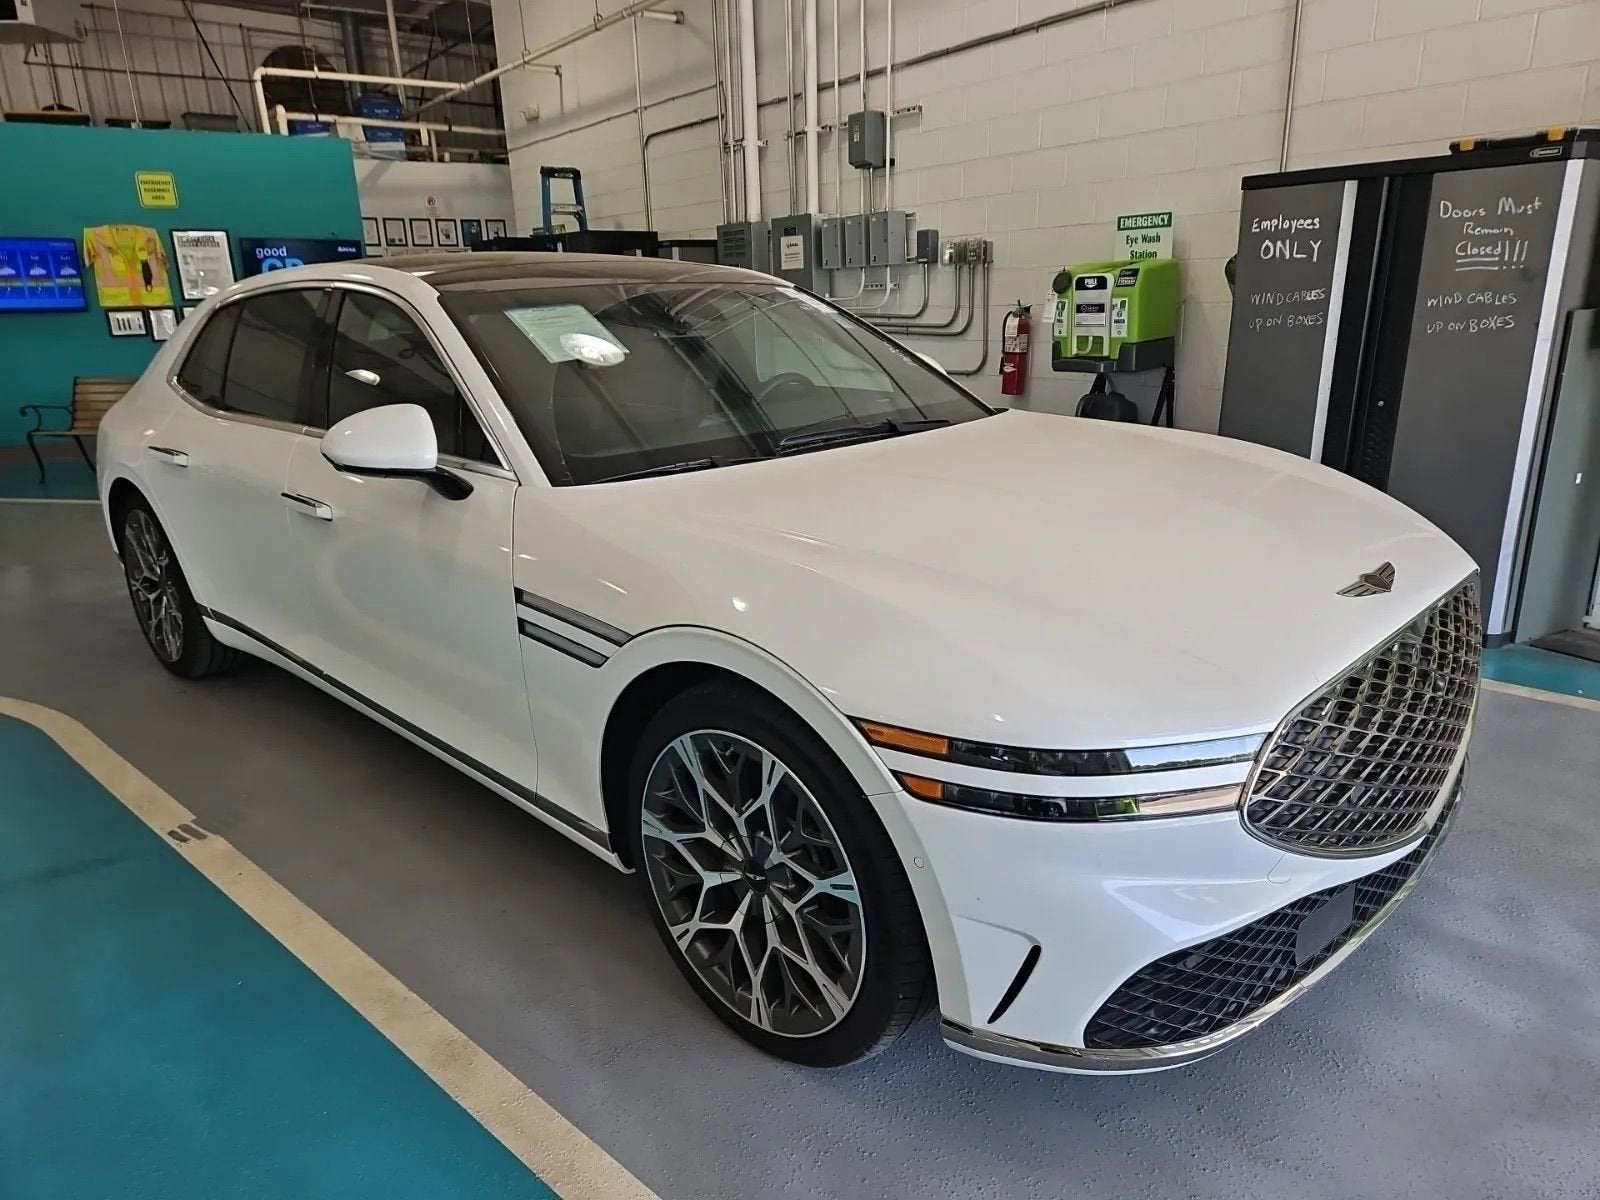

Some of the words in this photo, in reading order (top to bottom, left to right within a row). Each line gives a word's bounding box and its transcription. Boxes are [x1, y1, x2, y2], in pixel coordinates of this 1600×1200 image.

[1440, 200, 1486, 218] Doors
[1497, 196, 1542, 215] Must
[1120, 213, 1170, 229] EMERGENCY
[1251, 213, 1321, 233] Employees
[1463, 221, 1514, 236] Remain
[1125, 234, 1139, 248] Eye
[1141, 232, 1161, 244] Wash
[255, 246, 287, 259] good
[1130, 249, 1158, 260] Station
[1260, 239, 1322, 262] ONLY
[1251, 292, 1284, 306] WIND
[1286, 288, 1326, 303] CABLES
[1427, 292, 1462, 307] WIND
[1467, 292, 1518, 305] CABLES
[1266, 315, 1283, 327] ON
[1287, 312, 1323, 328] BOXES
[1427, 321, 1444, 334] UP
[1448, 321, 1466, 331] ON
[1469, 315, 1515, 333] BOXES
